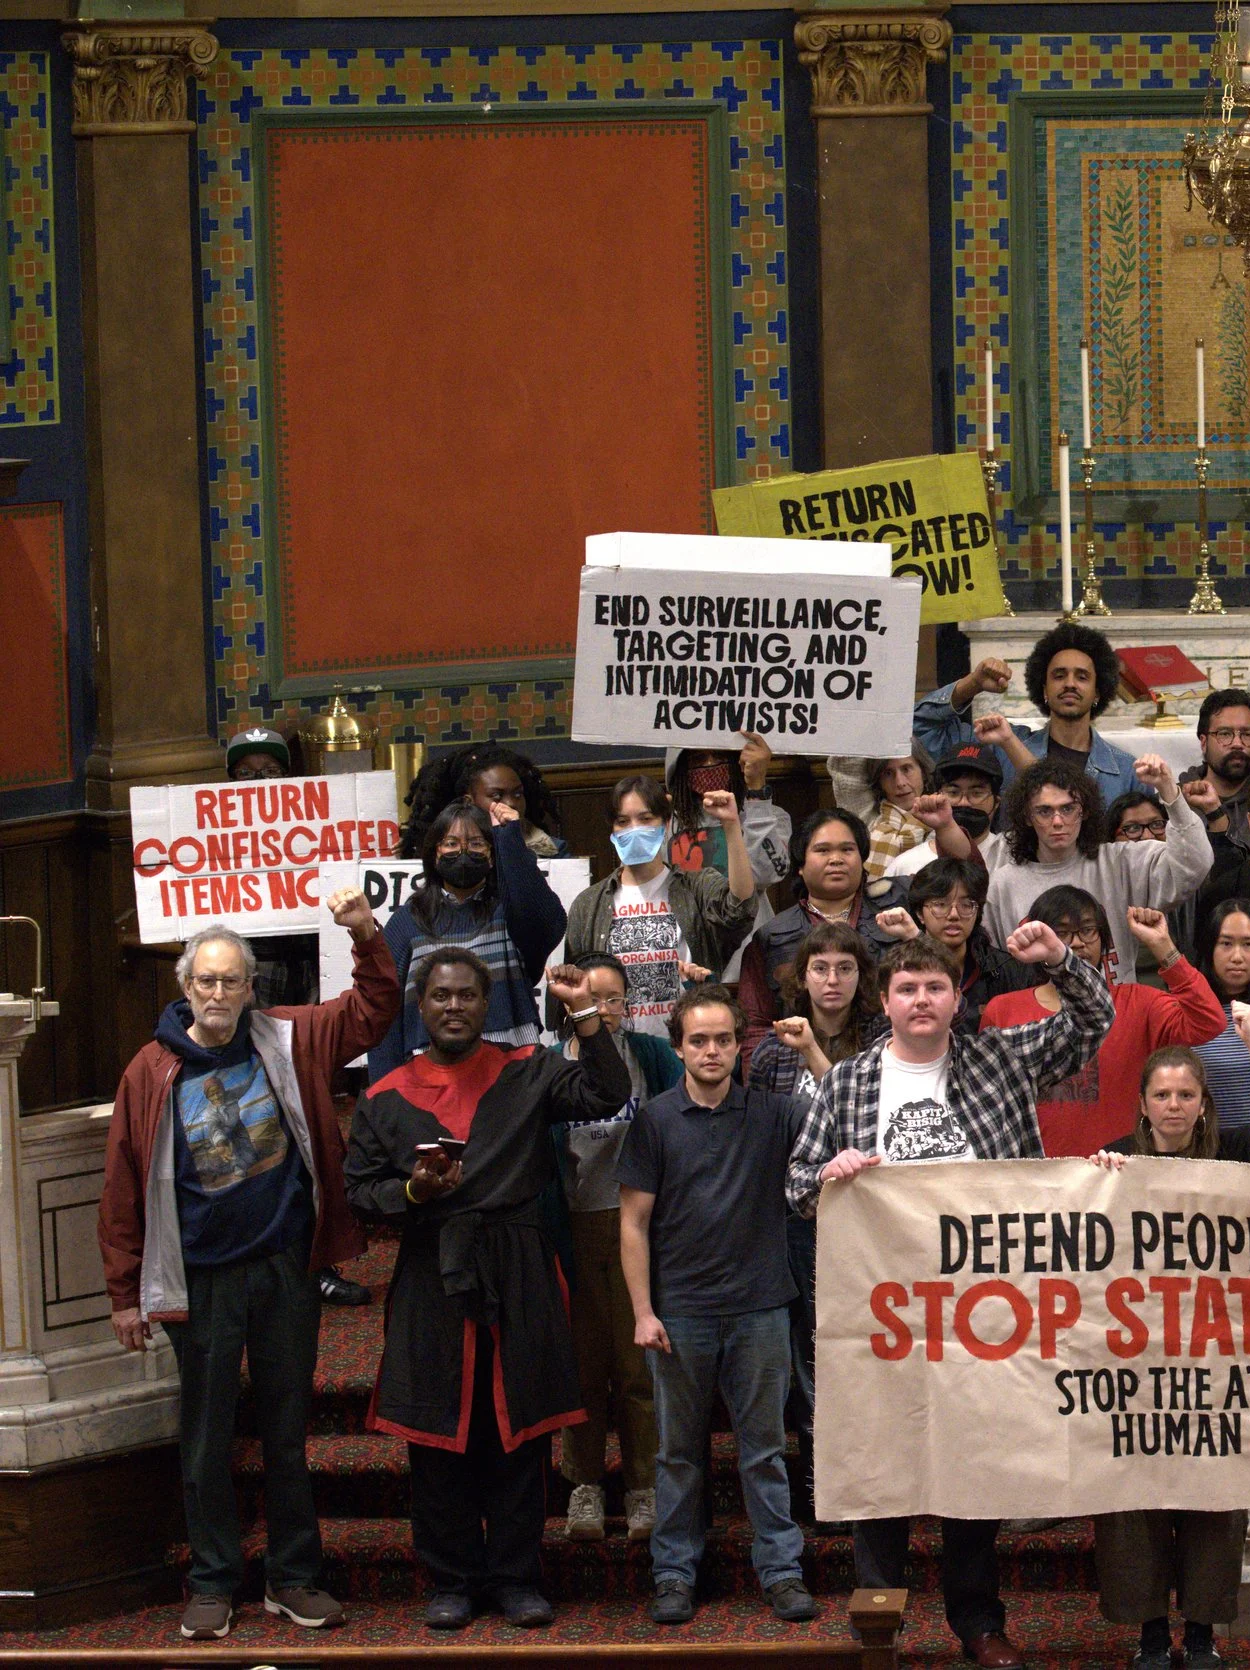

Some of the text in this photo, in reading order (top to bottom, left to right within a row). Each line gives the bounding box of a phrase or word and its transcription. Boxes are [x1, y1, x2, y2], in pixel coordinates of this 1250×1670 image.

[779, 480, 916, 535] RETURN
[594, 595, 887, 635] END SURVEILLANCE,
[613, 629, 867, 668] TARGETING, AND
[605, 664, 872, 700] INTIMIDATION OF
[653, 699, 818, 734] ACTIVISTS!
[195, 781, 330, 829] RETURN
[134, 820, 400, 877] CONFISCATED
[160, 869, 320, 918] ITEMS NO
[591, 1129, 609, 1140] USA
[901, 1107, 943, 1119] KAPIT
[940, 1211, 1115, 1275] DEFEND
[870, 1279, 1082, 1362] STOP
[1055, 1368, 1140, 1416] STOP
[1149, 1366, 1211, 1412] THE
[1112, 1413, 1241, 1457] HUMAN
